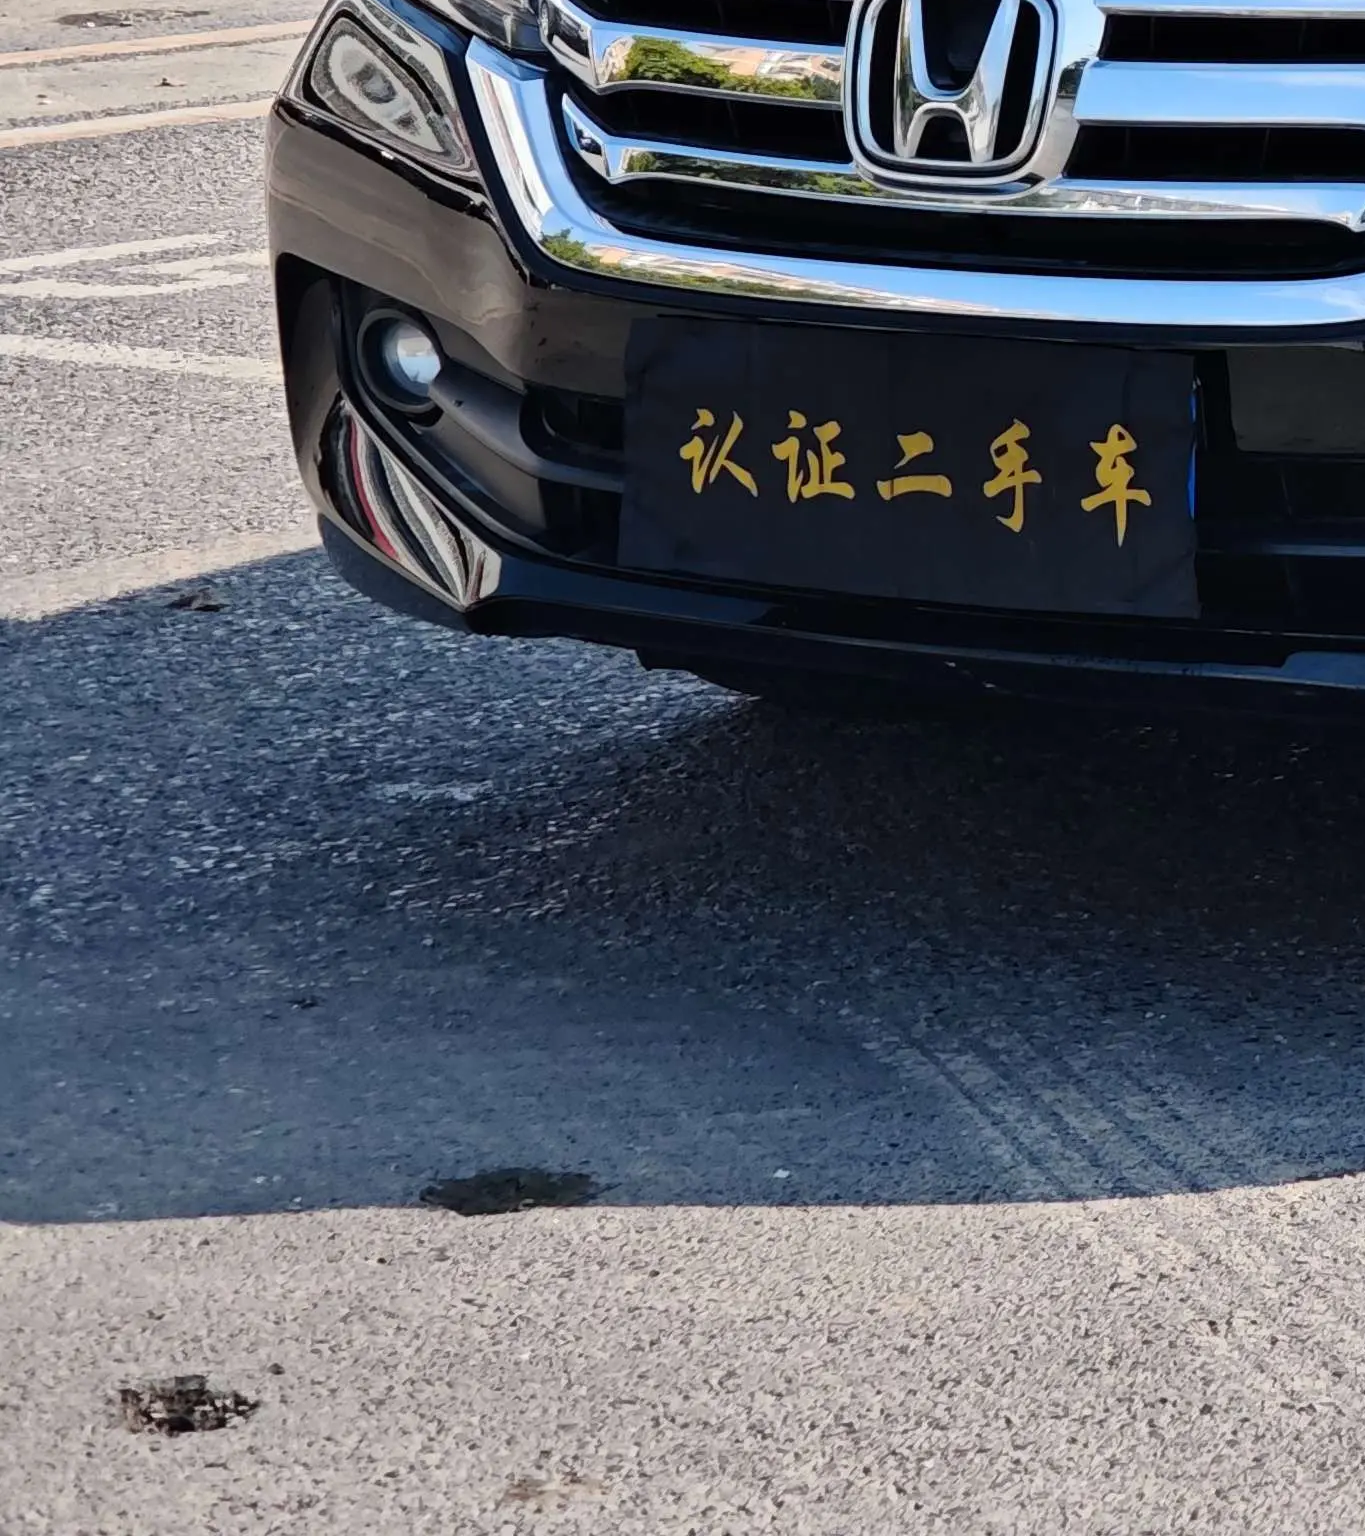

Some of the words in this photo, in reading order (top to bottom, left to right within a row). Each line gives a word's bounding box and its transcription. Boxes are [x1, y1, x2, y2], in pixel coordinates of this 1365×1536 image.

[679, 409, 1152, 547] 认证二手车
